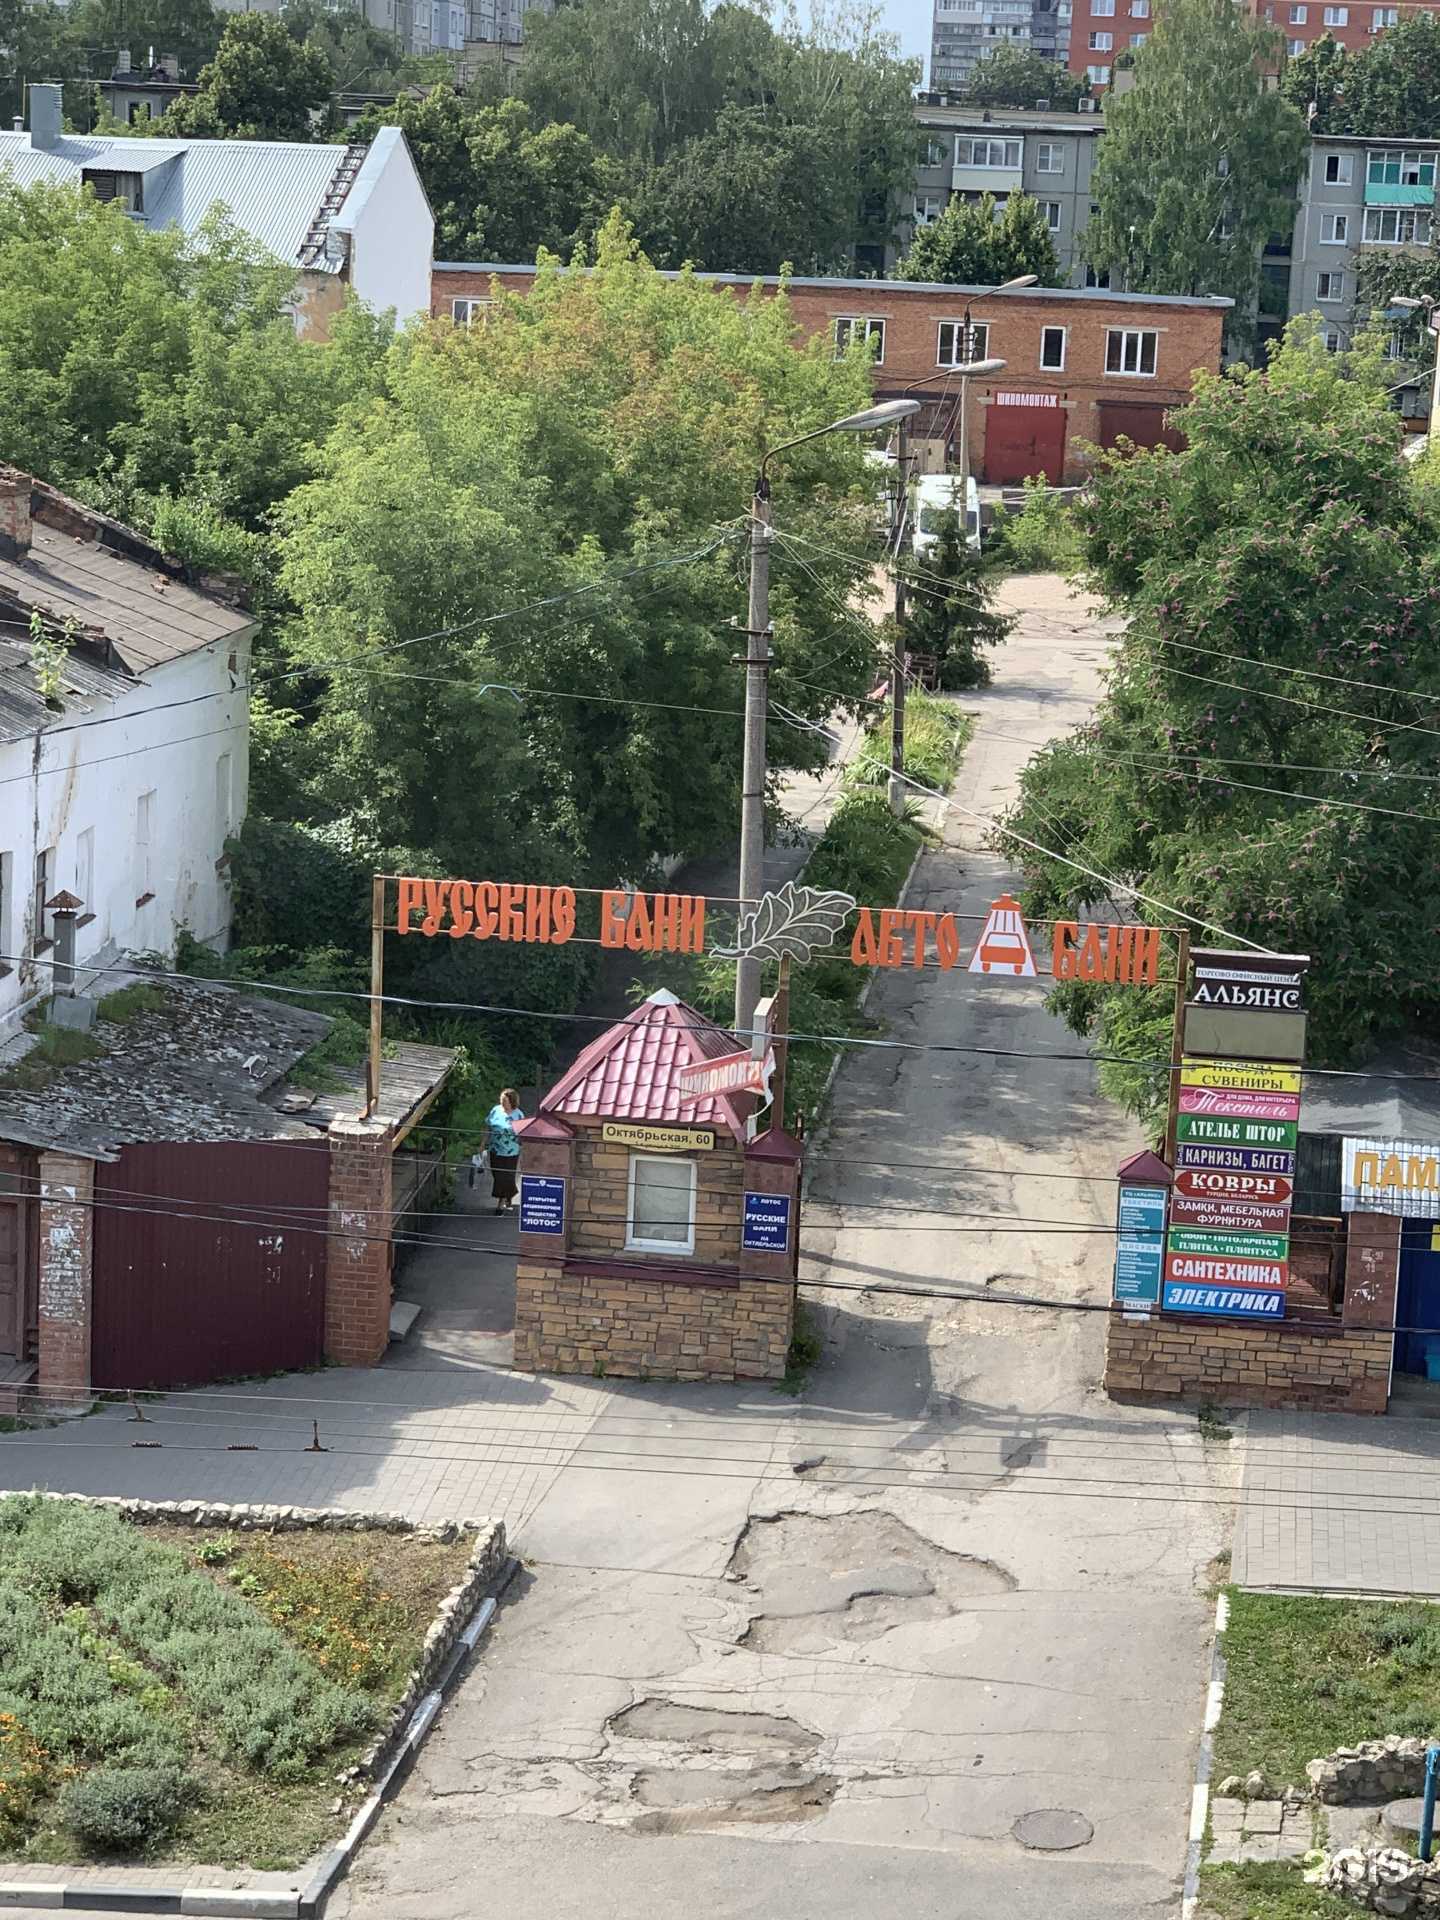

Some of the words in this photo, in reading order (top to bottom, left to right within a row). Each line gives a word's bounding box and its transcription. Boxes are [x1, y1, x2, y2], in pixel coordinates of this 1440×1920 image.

[997, 392, 1057, 408] ШИНОМОНТАЖ
[601, 890, 705, 953] БАНИ
[852, 907, 960, 971] АВТО
[1053, 920, 1160, 985] БАНИ
[1194, 983, 1300, 1008] АЛЬЯНС
[1202, 1074, 1283, 1090] СУВЕНИРЫ
[1181, 1088, 1288, 1117] Текстиль
[606, 1126, 692, 1144] Октябрьская,
[696, 1134, 710, 1145] 60
[1188, 1120, 1240, 1139] АТЕЛЬЕ
[1245, 1124, 1285, 1142] ШТОР
[1185, 1148, 1247, 1169] КАРНИЗЫ,
[1251, 1153, 1286, 1170] БАГЕТ
[1190, 1173, 1277, 1195] КОВРЫ
[746, 1213, 786, 1223] РУССКИЕ
[1177, 1201, 1217, 1213] ЗАМКИ,
[1220, 1204, 1284, 1218] МЕБЕЛЬНАЯ
[1197, 1215, 1262, 1228] ФУРНИТУРА
[1179, 1242, 1219, 1252] ПЛИТКА
[1172, 1259, 1281, 1285] САНТЕХНИКА
[1168, 1288, 1280, 1312] ЭЛЕКТРИКА
